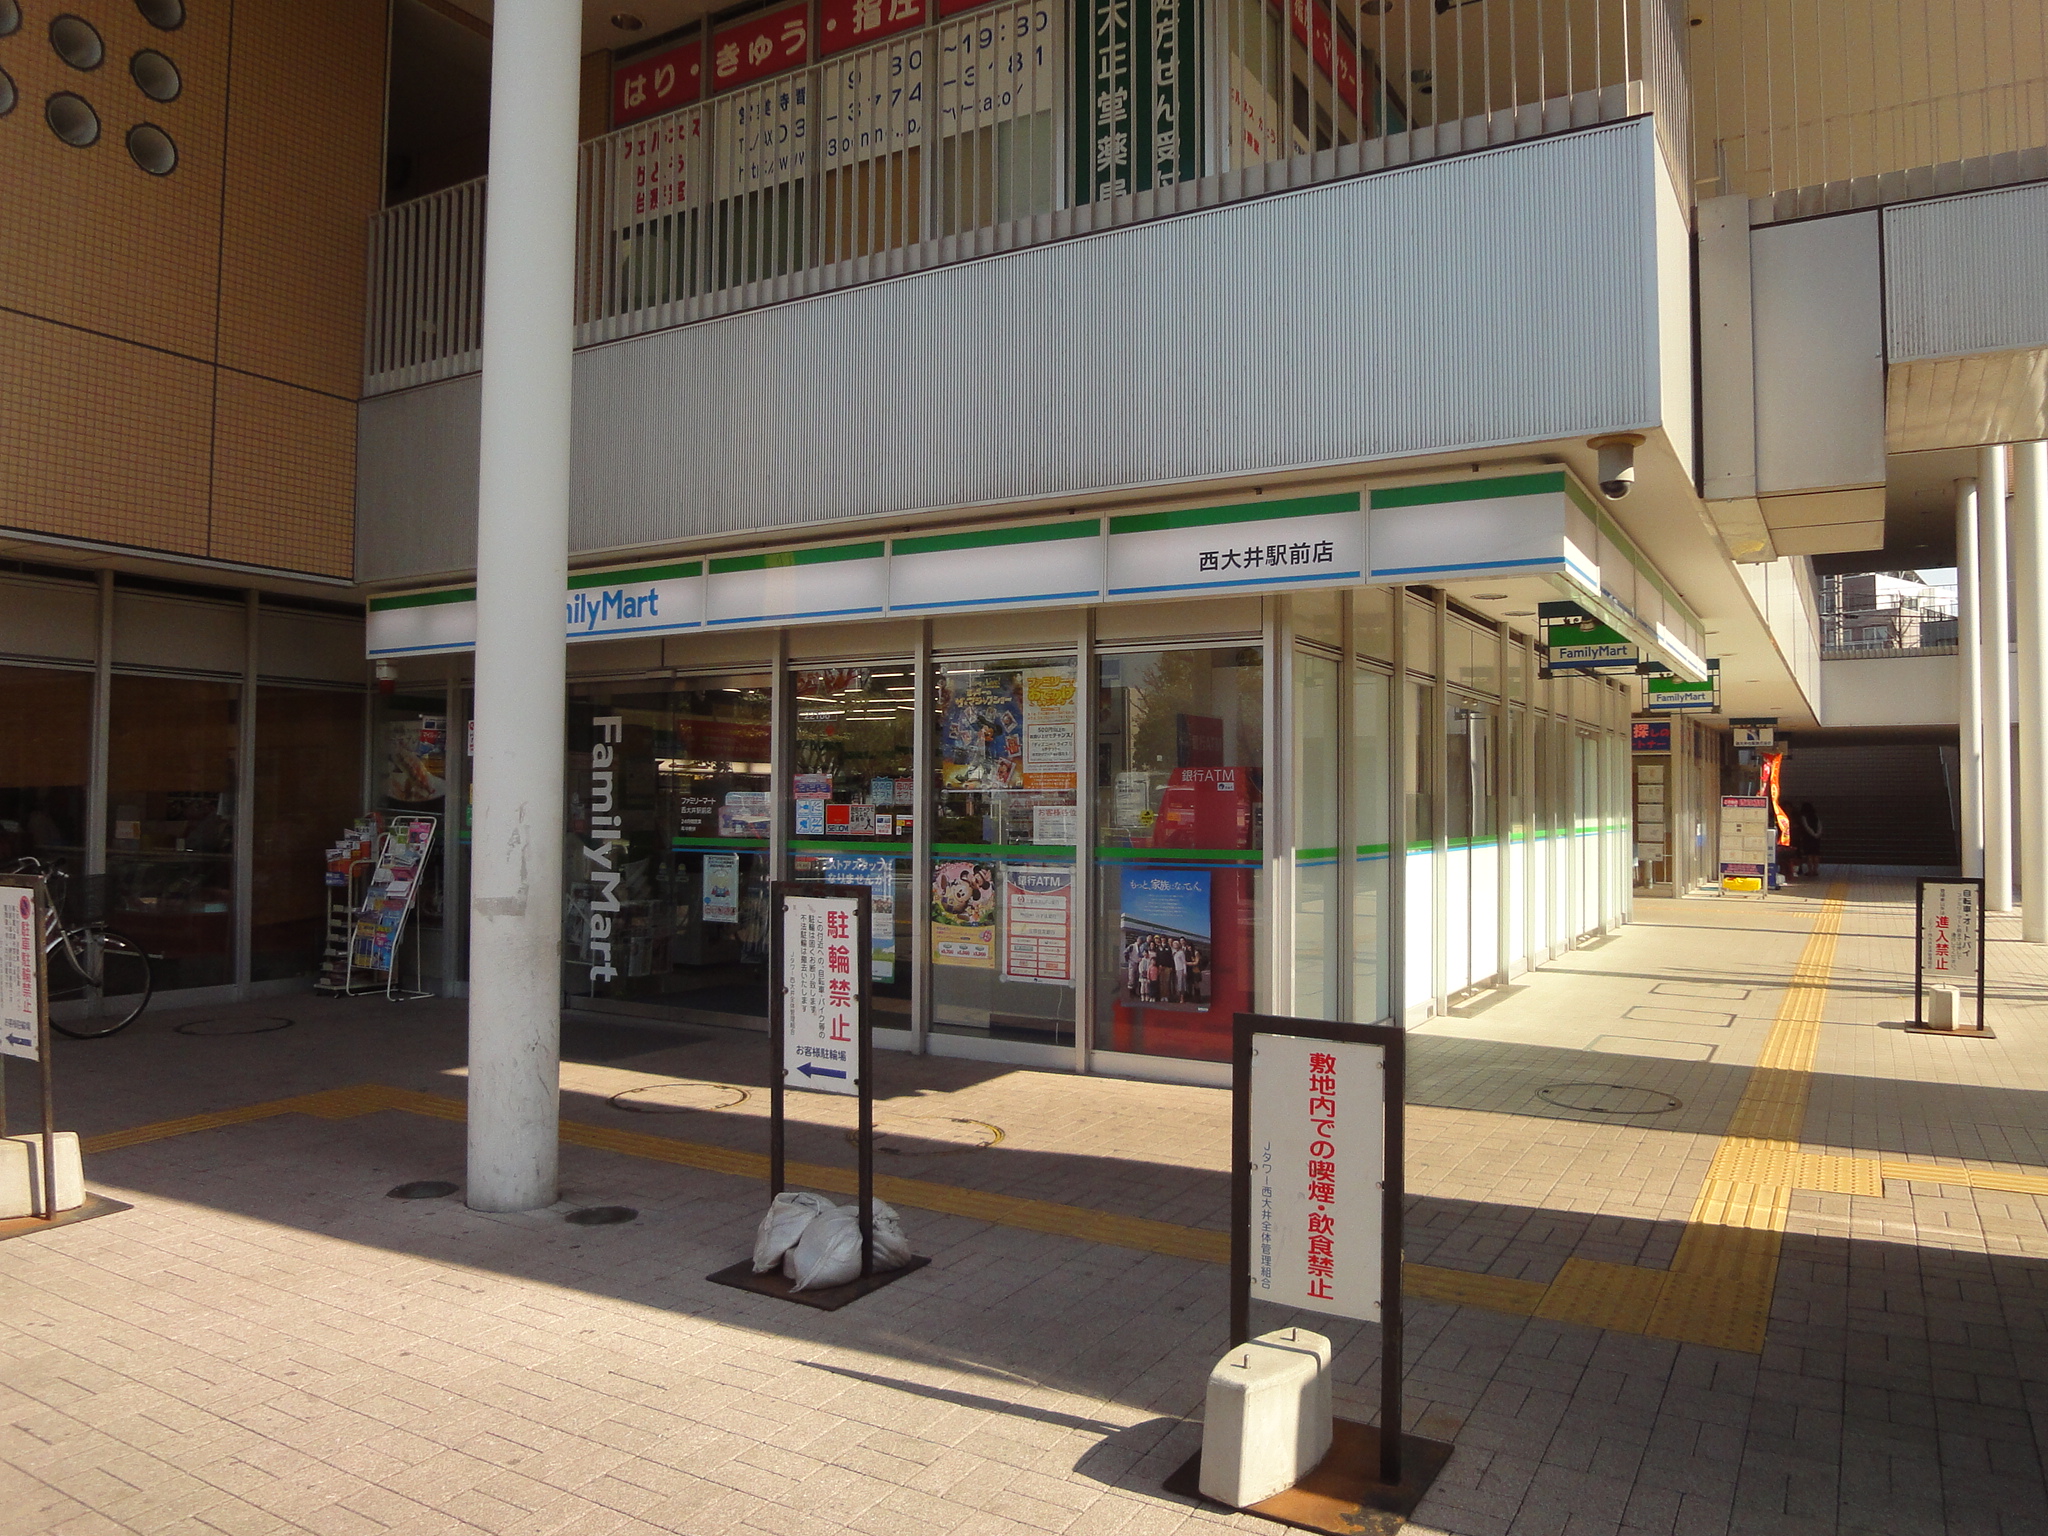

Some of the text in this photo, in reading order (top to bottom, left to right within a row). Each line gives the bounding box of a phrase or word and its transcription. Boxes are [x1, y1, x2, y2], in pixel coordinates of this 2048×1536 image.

[1199, 540, 1334, 571] 西大井駅前店
[1559, 645, 1628, 660] FamilyMart
[1656, 692, 1706, 703] FamilyMart
[1181, 769, 1235, 782] 銀行ATM
[680, 797, 717, 805] ファミリーマート
[583, 716, 622, 983] FamilyMart
[1017, 874, 1061, 887] 銀行ATM
[1962, 889, 1972, 957] 自転車・オートバイ
[1935, 915, 1949, 970] 進入禁止
[827, 910, 851, 1042] 駐輪禁止
[796, 1045, 847, 1062] お客様駐輪場
[1307, 1052, 1337, 1301] 敷地内での喫煙・飲食禁止
[1260, 1141, 1273, 1290] Jタワー西大井全体管理組合
